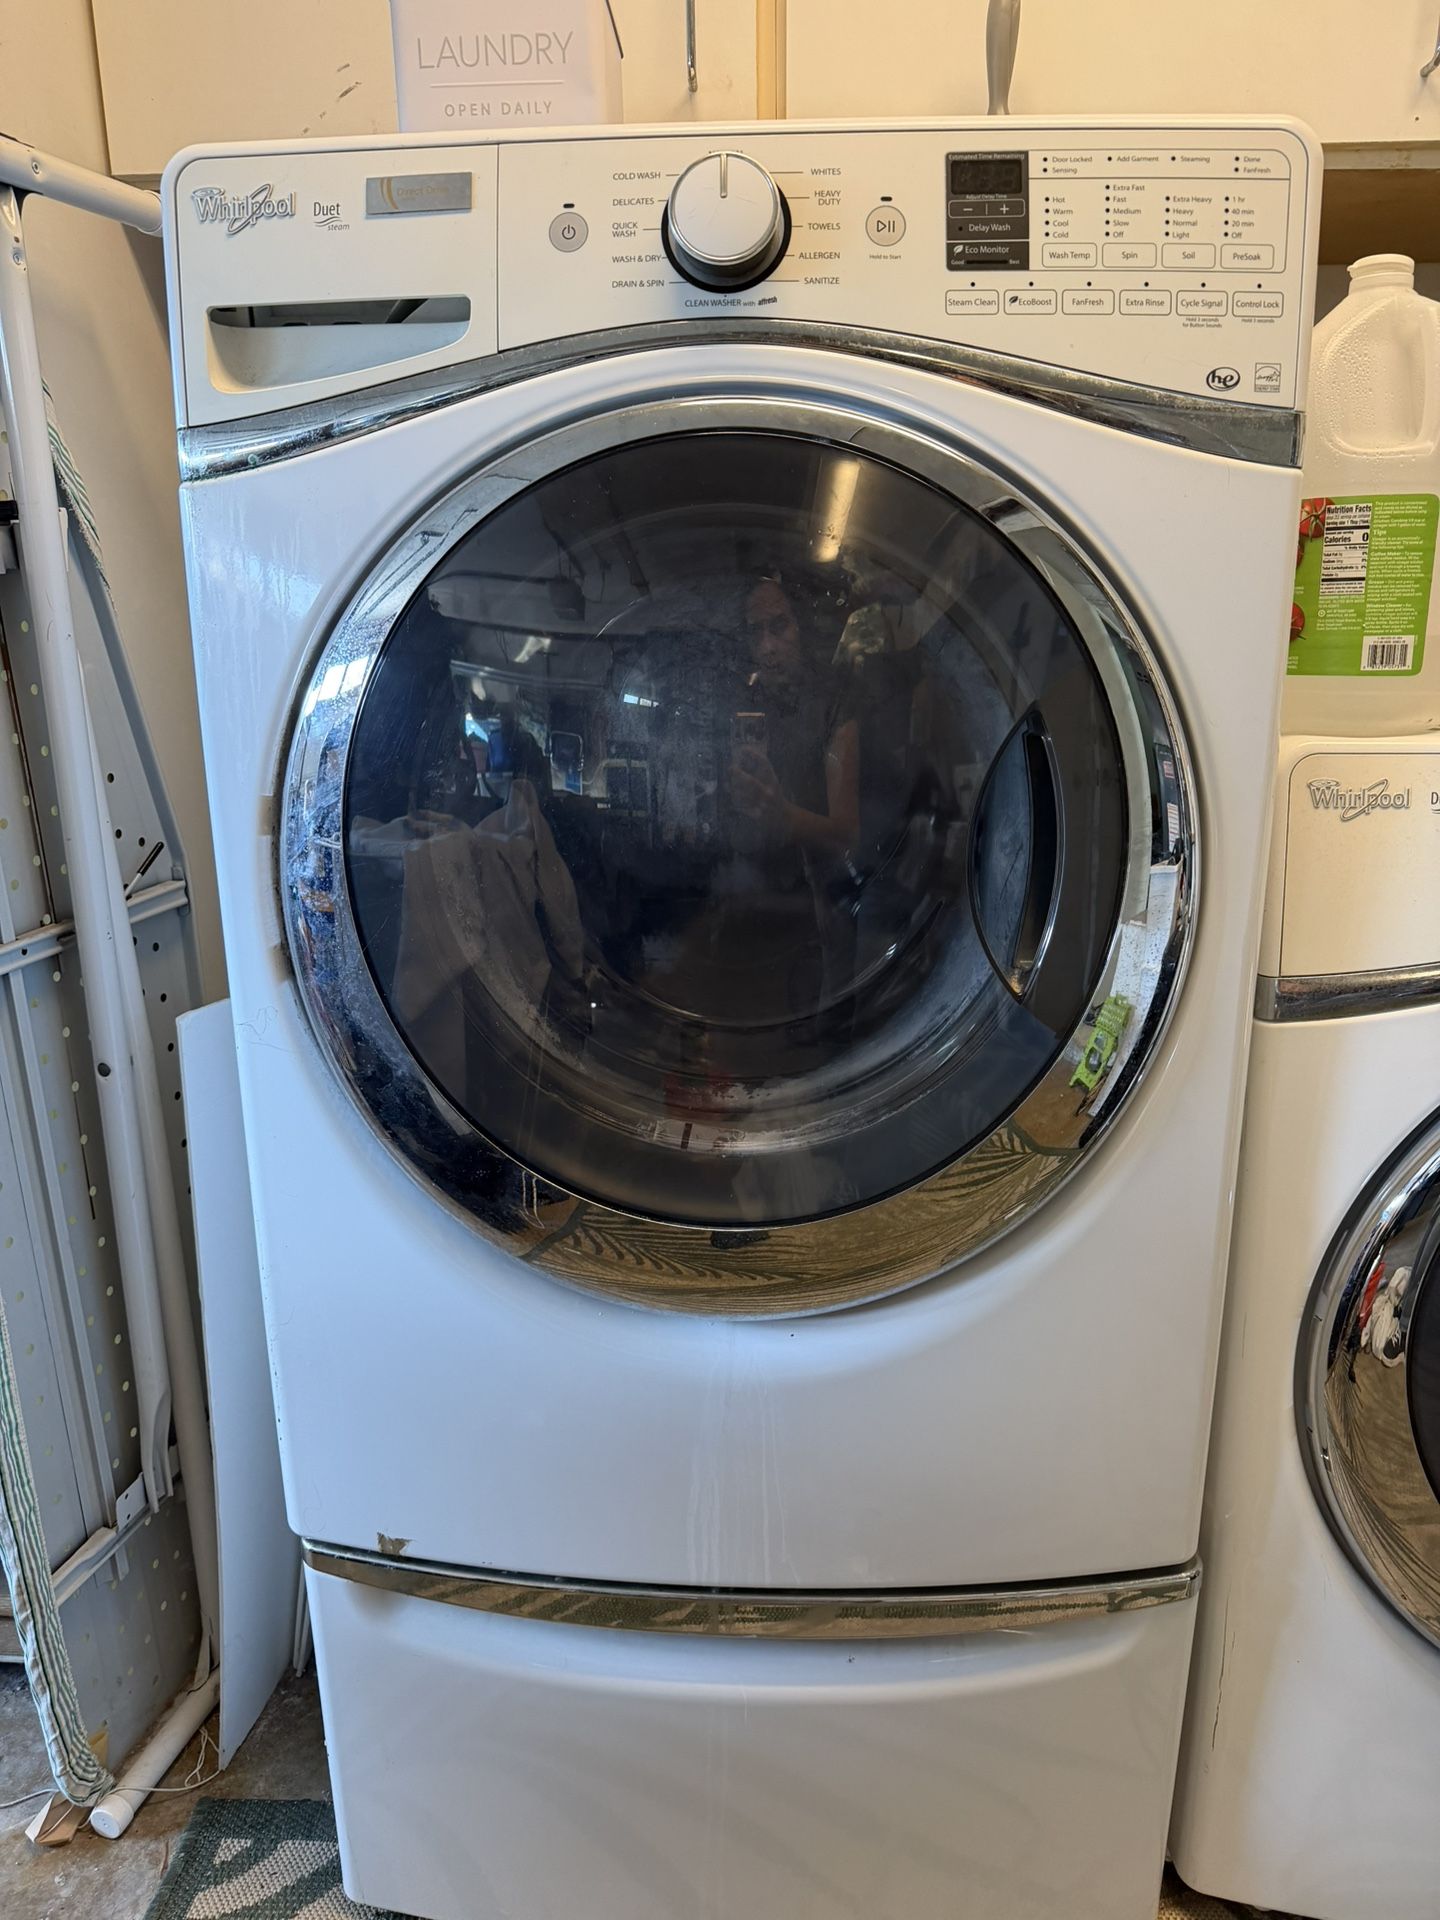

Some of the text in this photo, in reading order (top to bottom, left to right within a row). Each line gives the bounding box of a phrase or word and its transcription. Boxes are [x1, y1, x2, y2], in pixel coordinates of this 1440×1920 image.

[417, 31, 574, 69] LAUNDRY
[444, 100, 552, 117] OPEN DAILY
[1180, 156, 1211, 164] Steaming
[613, 170, 661, 181] COLD WASH
[811, 167, 842, 176] WHITES
[814, 189, 841, 198] HEAVY
[612, 197, 655, 207] DELICATES
[818, 197, 841, 206] DUTY
[1191, 196, 1212, 204] Heavy
[192, 184, 296, 234] Whirlpool
[313, 201, 341, 216] Duet
[1172, 208, 1194, 216] Heavy
[327, 223, 350, 231] steam
[612, 221, 638, 230] QUICK
[808, 222, 841, 231] TOWELS
[968, 223, 1011, 233] Delay Wash
[612, 229, 636, 238] WASH
[965, 245, 1010, 254] Eco Monitor
[612, 254, 662, 263] WASH & DRY
[798, 251, 841, 260] ALLERGEN
[1048, 251, 1091, 260] Wash Temp
[1121, 251, 1138, 260] Spin
[1182, 251, 1196, 260] Soil
[1232, 252, 1261, 261] PreSoak
[612, 278, 665, 288] DRAIN & SPIN
[804, 276, 840, 285] SANITIZE
[684, 299, 709, 308] CLEAN
[710, 298, 742, 307] WASHER
[947, 298, 996, 306] Steam Clean
[1018, 298, 1052, 306] EcoBoost
[1072, 298, 1104, 306] FanFresh
[1125, 298, 1165, 307] Extra Rinse
[1180, 299, 1223, 309] Cycle Signal
[1235, 300, 1280, 308] Control Lock
[1211, 369, 1235, 388] he
[1326, 504, 1371, 514] Nutrition Facts
[1324, 536, 1352, 544] Calories
[1362, 532, 1369, 542] 0
[1306, 777, 1411, 822] Whirlpool
